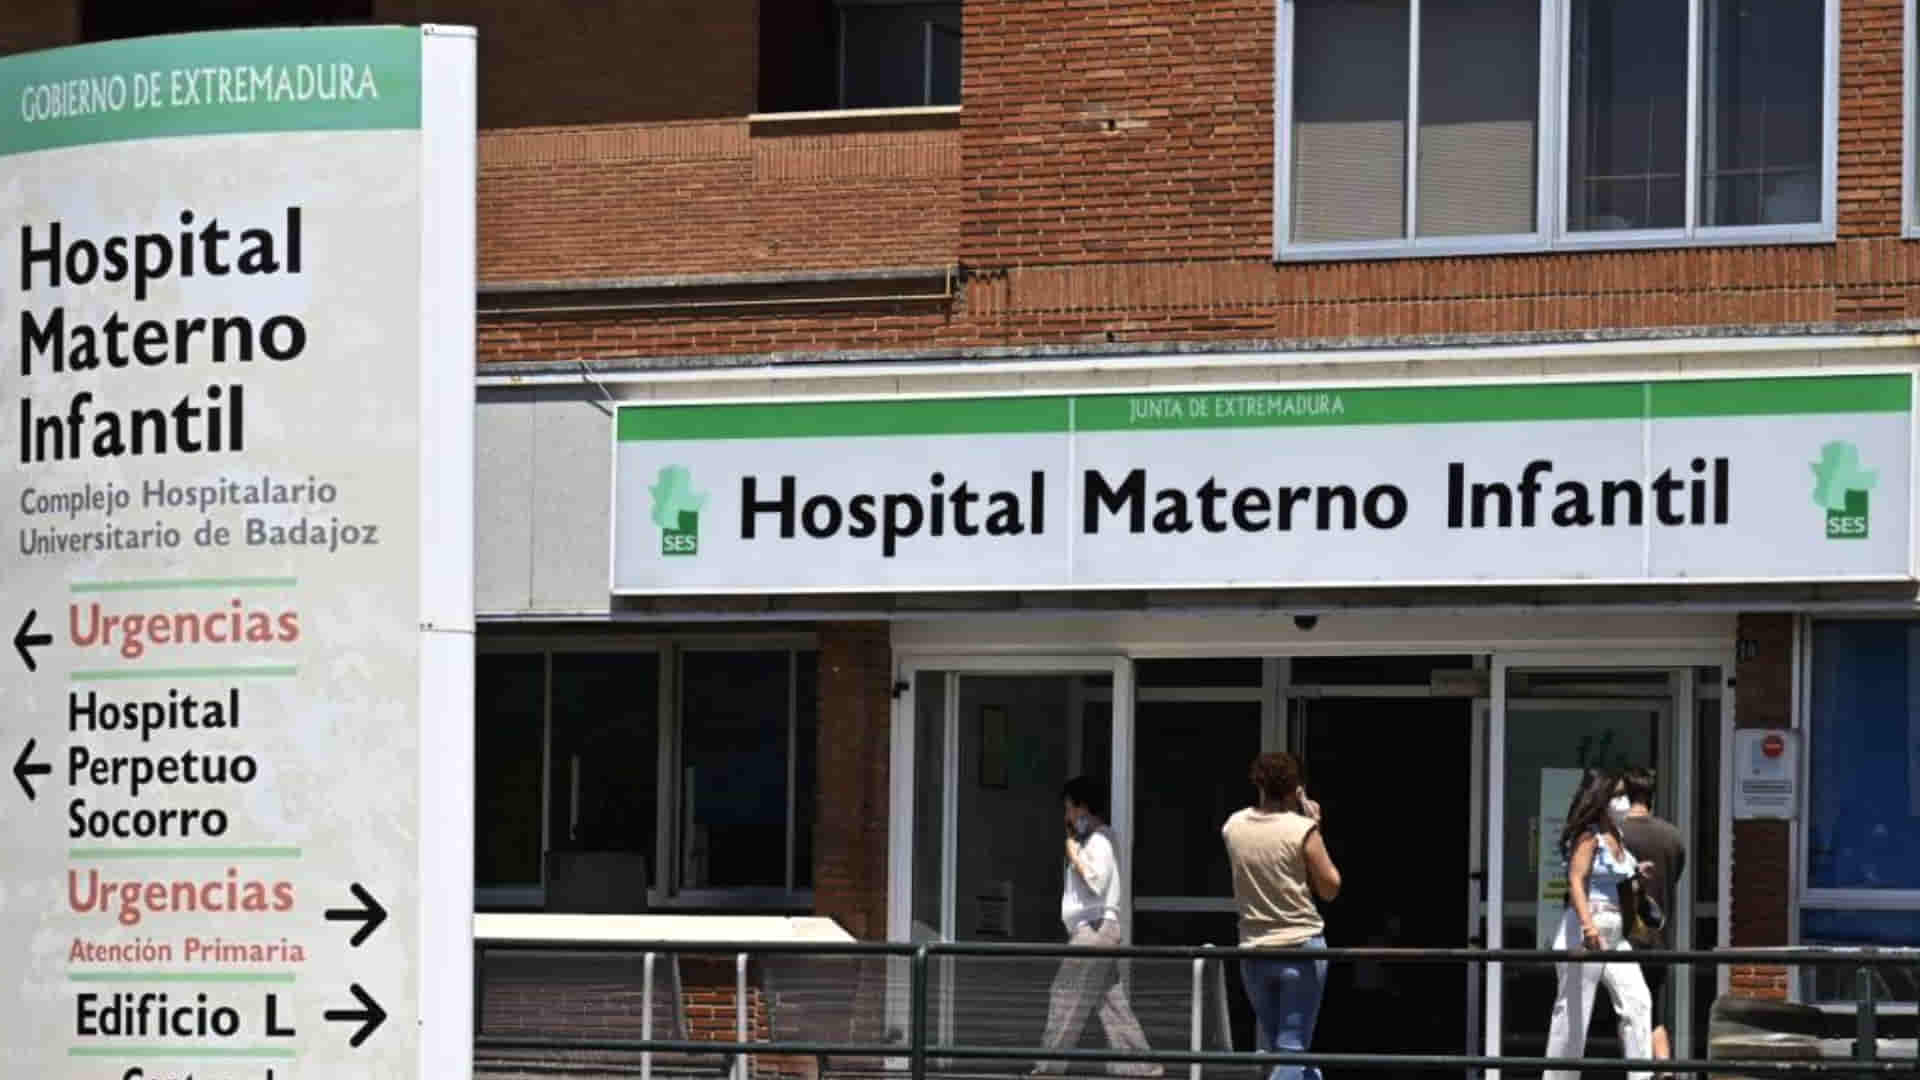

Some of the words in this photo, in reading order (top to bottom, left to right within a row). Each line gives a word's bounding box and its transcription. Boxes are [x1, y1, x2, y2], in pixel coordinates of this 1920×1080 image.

[21, 75, 127, 122] GOBIERNO
[133, 71, 162, 109] DE
[170, 63, 378, 107] EXTREMADURA
[20, 206, 303, 301] Hospital
[20, 306, 306, 376] Materno
[20, 384, 244, 464] Infantil
[1128, 399, 1183, 424] JUNTA
[1188, 398, 1209, 418] DE
[1215, 392, 1345, 417] EXTREMADURA
[20, 482, 131, 521] Complejo
[142, 476, 337, 517] Hospitalario
[741, 471, 1044, 557] Hospital
[1083, 469, 1409, 534] Materno
[1447, 457, 1729, 528] Infantil
[19, 521, 181, 556] Universitario
[193, 519, 230, 547] de
[245, 516, 378, 552] Badajoz
[663, 535, 697, 552] SES
[1828, 517, 1865, 534] SES
[69, 599, 300, 660] Urgencias
[69, 688, 239, 742] Hospital
[69, 746, 257, 797] Perpetuo
[69, 798, 228, 838] Socorro
[68, 868, 294, 926] Urgencias
[69, 937, 172, 963] Atención
[184, 938, 305, 963] Primaria
[77, 993, 239, 1037] Edificio
[265, 994, 296, 1036] L
